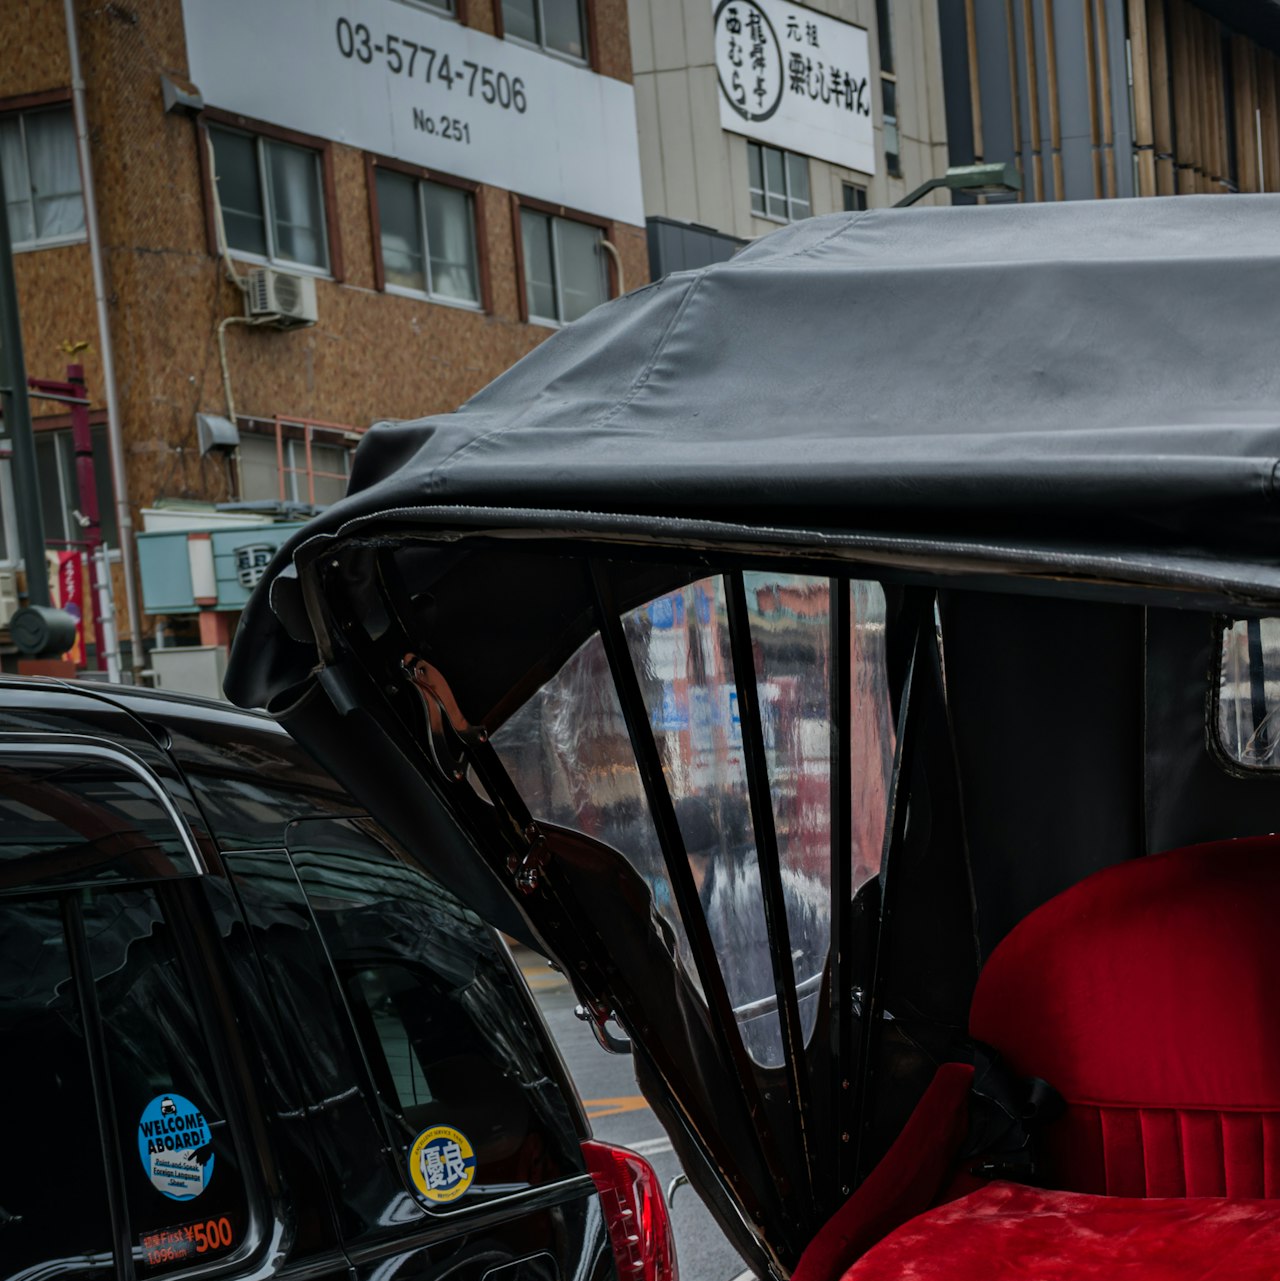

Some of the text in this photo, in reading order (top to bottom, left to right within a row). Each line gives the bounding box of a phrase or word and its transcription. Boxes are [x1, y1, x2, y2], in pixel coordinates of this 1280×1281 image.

[786, 15, 820, 48] 元祖
[336, 16, 527, 114] 03-5774-7506
[726, 7, 746, 105] 西むら
[789, 51, 869, 117] 栗むし羊かん
[412, 107, 471, 144] No.251
[140, 1113, 204, 1137] WELCOME
[148, 1129, 205, 1155] ABOARD!
[153, 1166, 201, 1181] Foreign Language
[420, 1141, 468, 1190] 優良
